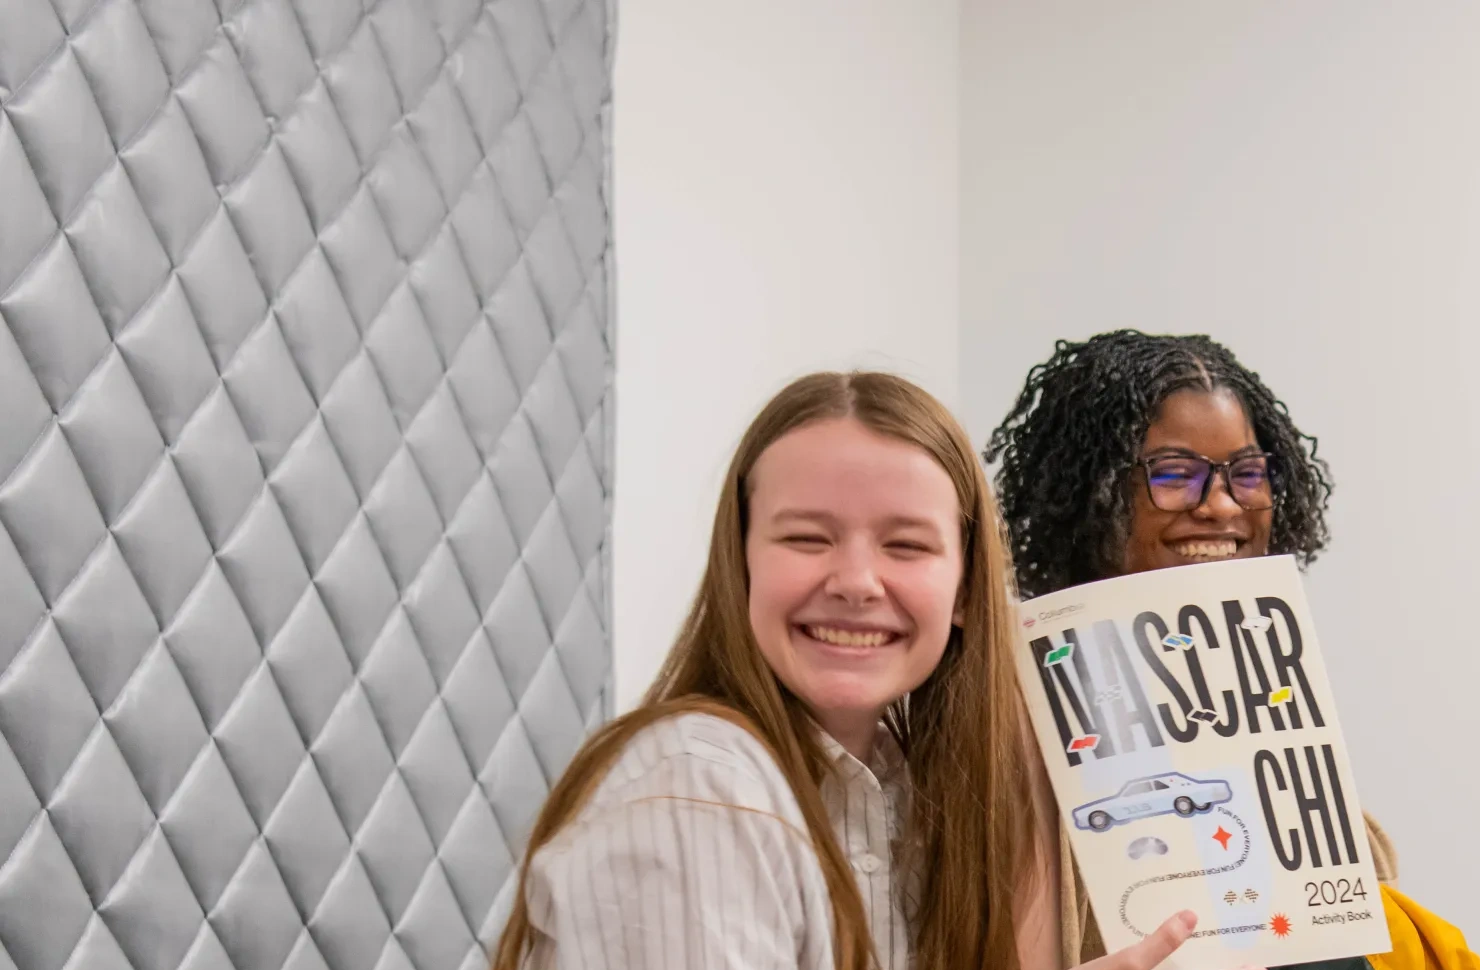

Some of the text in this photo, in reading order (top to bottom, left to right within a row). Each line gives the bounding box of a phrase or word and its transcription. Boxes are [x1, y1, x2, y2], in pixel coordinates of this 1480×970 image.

[1028, 596, 1327, 768] NASCAR
[1217, 806, 1233, 818] FUN
[1232, 814, 1246, 829] FOR
[1254, 744, 1361, 872] CHI
[1304, 877, 1368, 907] 2024
[1311, 908, 1373, 926] Activity Book
[1202, 927, 1217, 938] FUN
[1217, 926, 1231, 936] FOR
